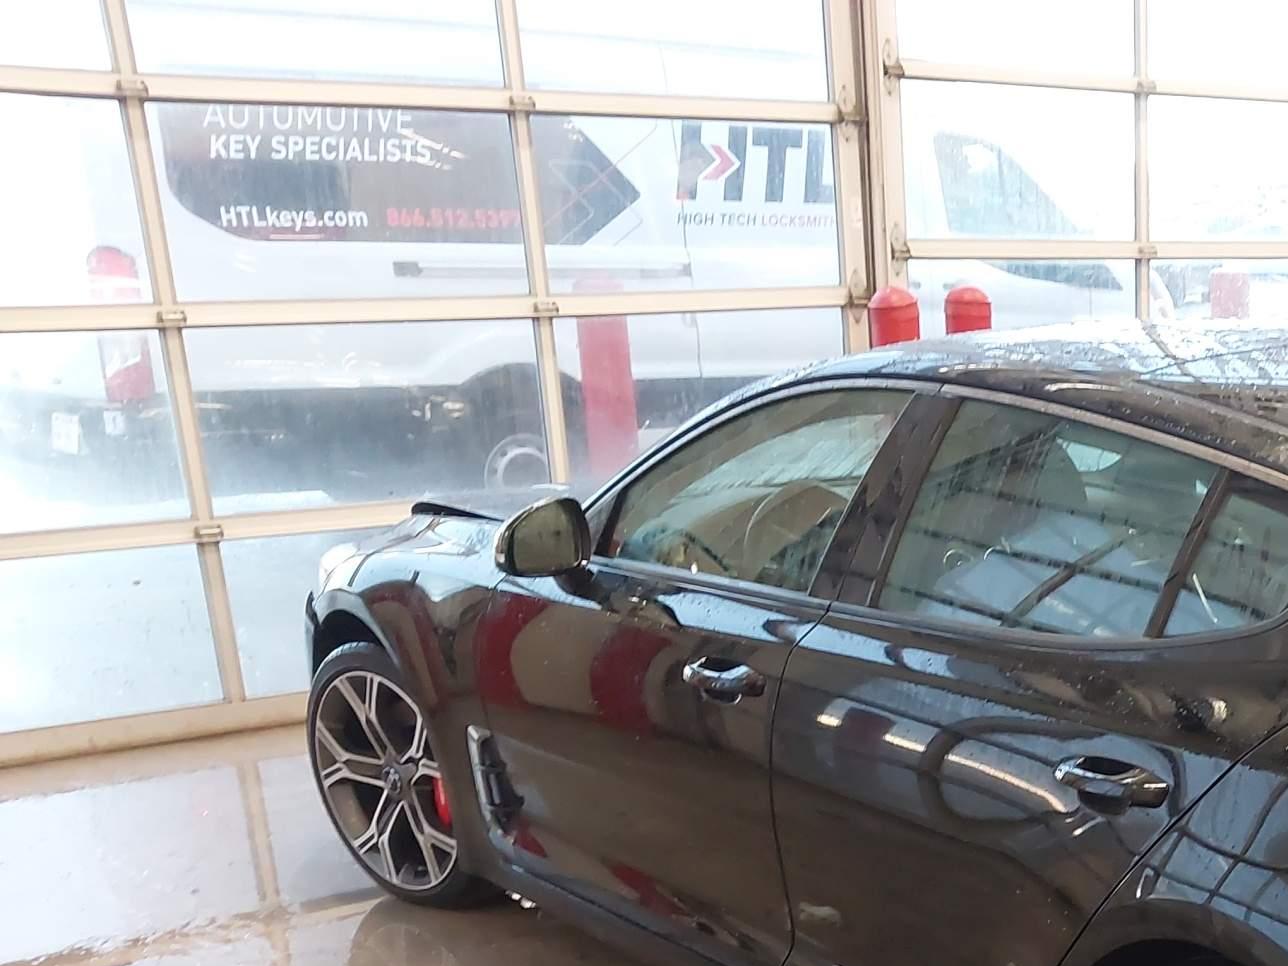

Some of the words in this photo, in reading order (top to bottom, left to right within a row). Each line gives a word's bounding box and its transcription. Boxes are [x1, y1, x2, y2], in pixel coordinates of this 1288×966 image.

[203, 104, 414, 133] AUTOMOTIVE
[210, 133, 262, 160] KEY
[271, 135, 434, 163] SPECIALISTS
[219, 205, 369, 232] HTLkeys.com
[677, 212, 715, 226] HIGH
[720, 213, 757, 227] TECH
